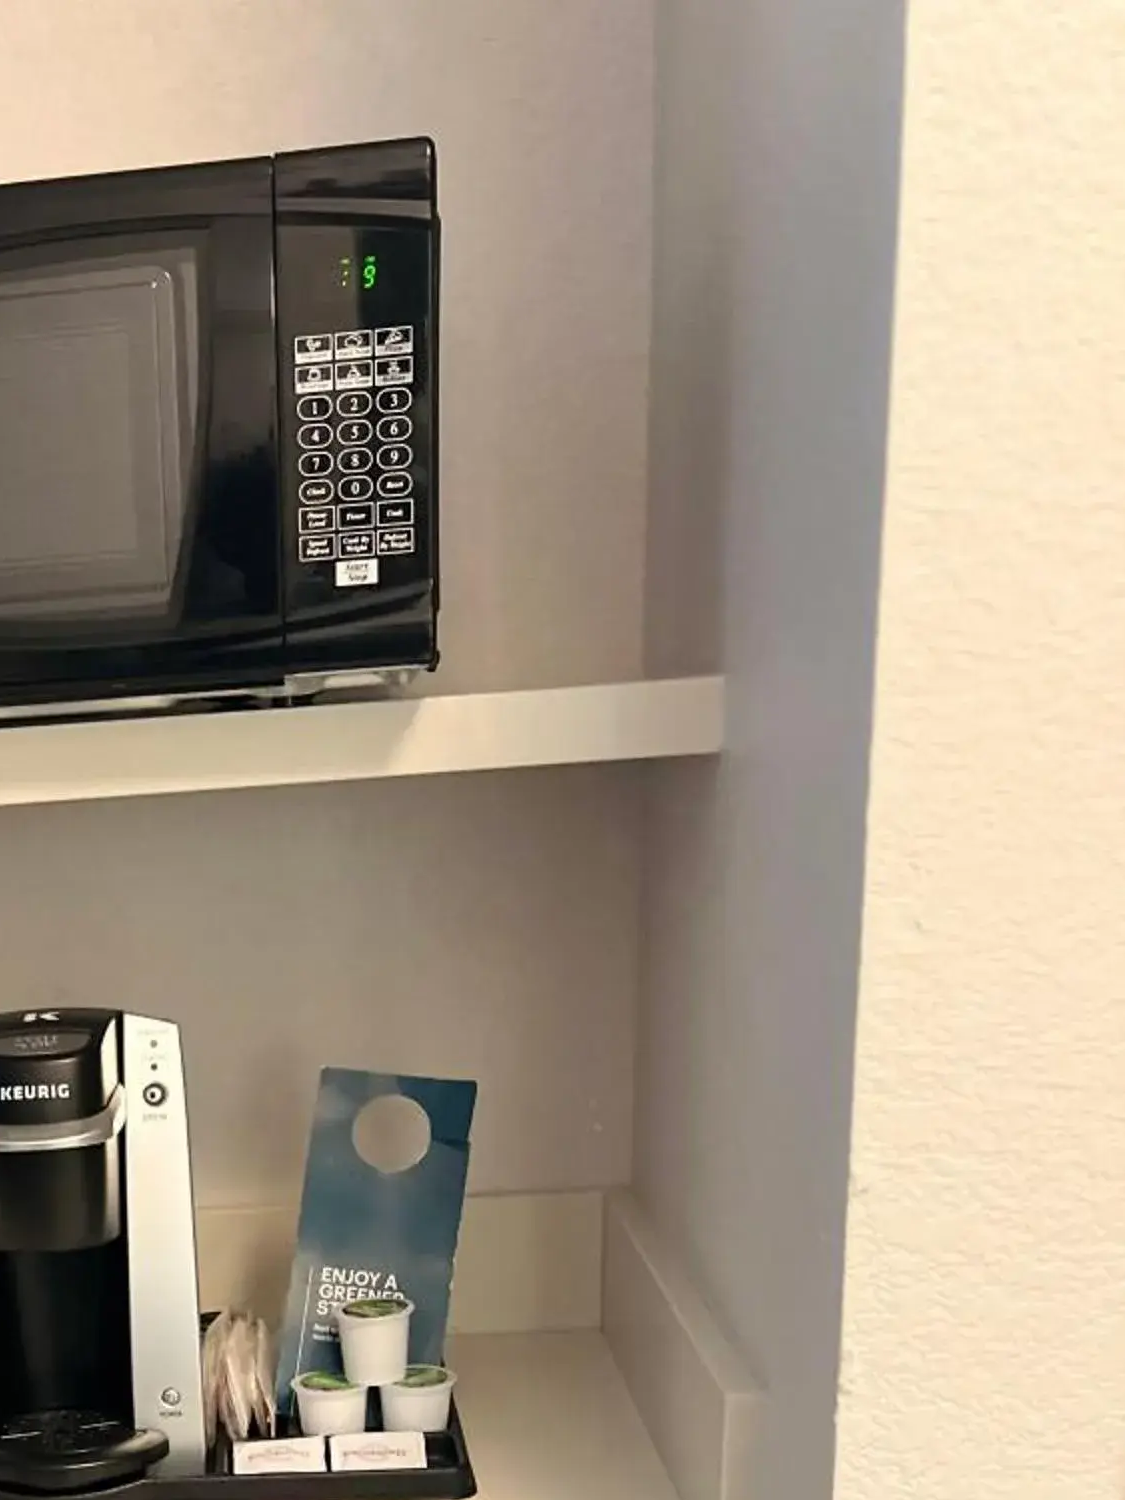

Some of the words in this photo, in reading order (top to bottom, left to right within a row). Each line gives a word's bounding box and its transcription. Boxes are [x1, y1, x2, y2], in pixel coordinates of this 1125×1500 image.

[350, 398, 358, 411] 2
[390, 393, 398, 406] 3
[350, 426, 359, 439] 5
[390, 423, 398, 435] 6
[311, 430, 320, 442] 4
[351, 454, 360, 467] 8
[390, 451, 399, 463] 9
[312, 458, 320, 470] 7
[350, 482, 360, 495] 0
[0, 1083, 71, 1101] KEURIG
[321, 1266, 381, 1287] ENJOY
[384, 1273, 398, 1290] A
